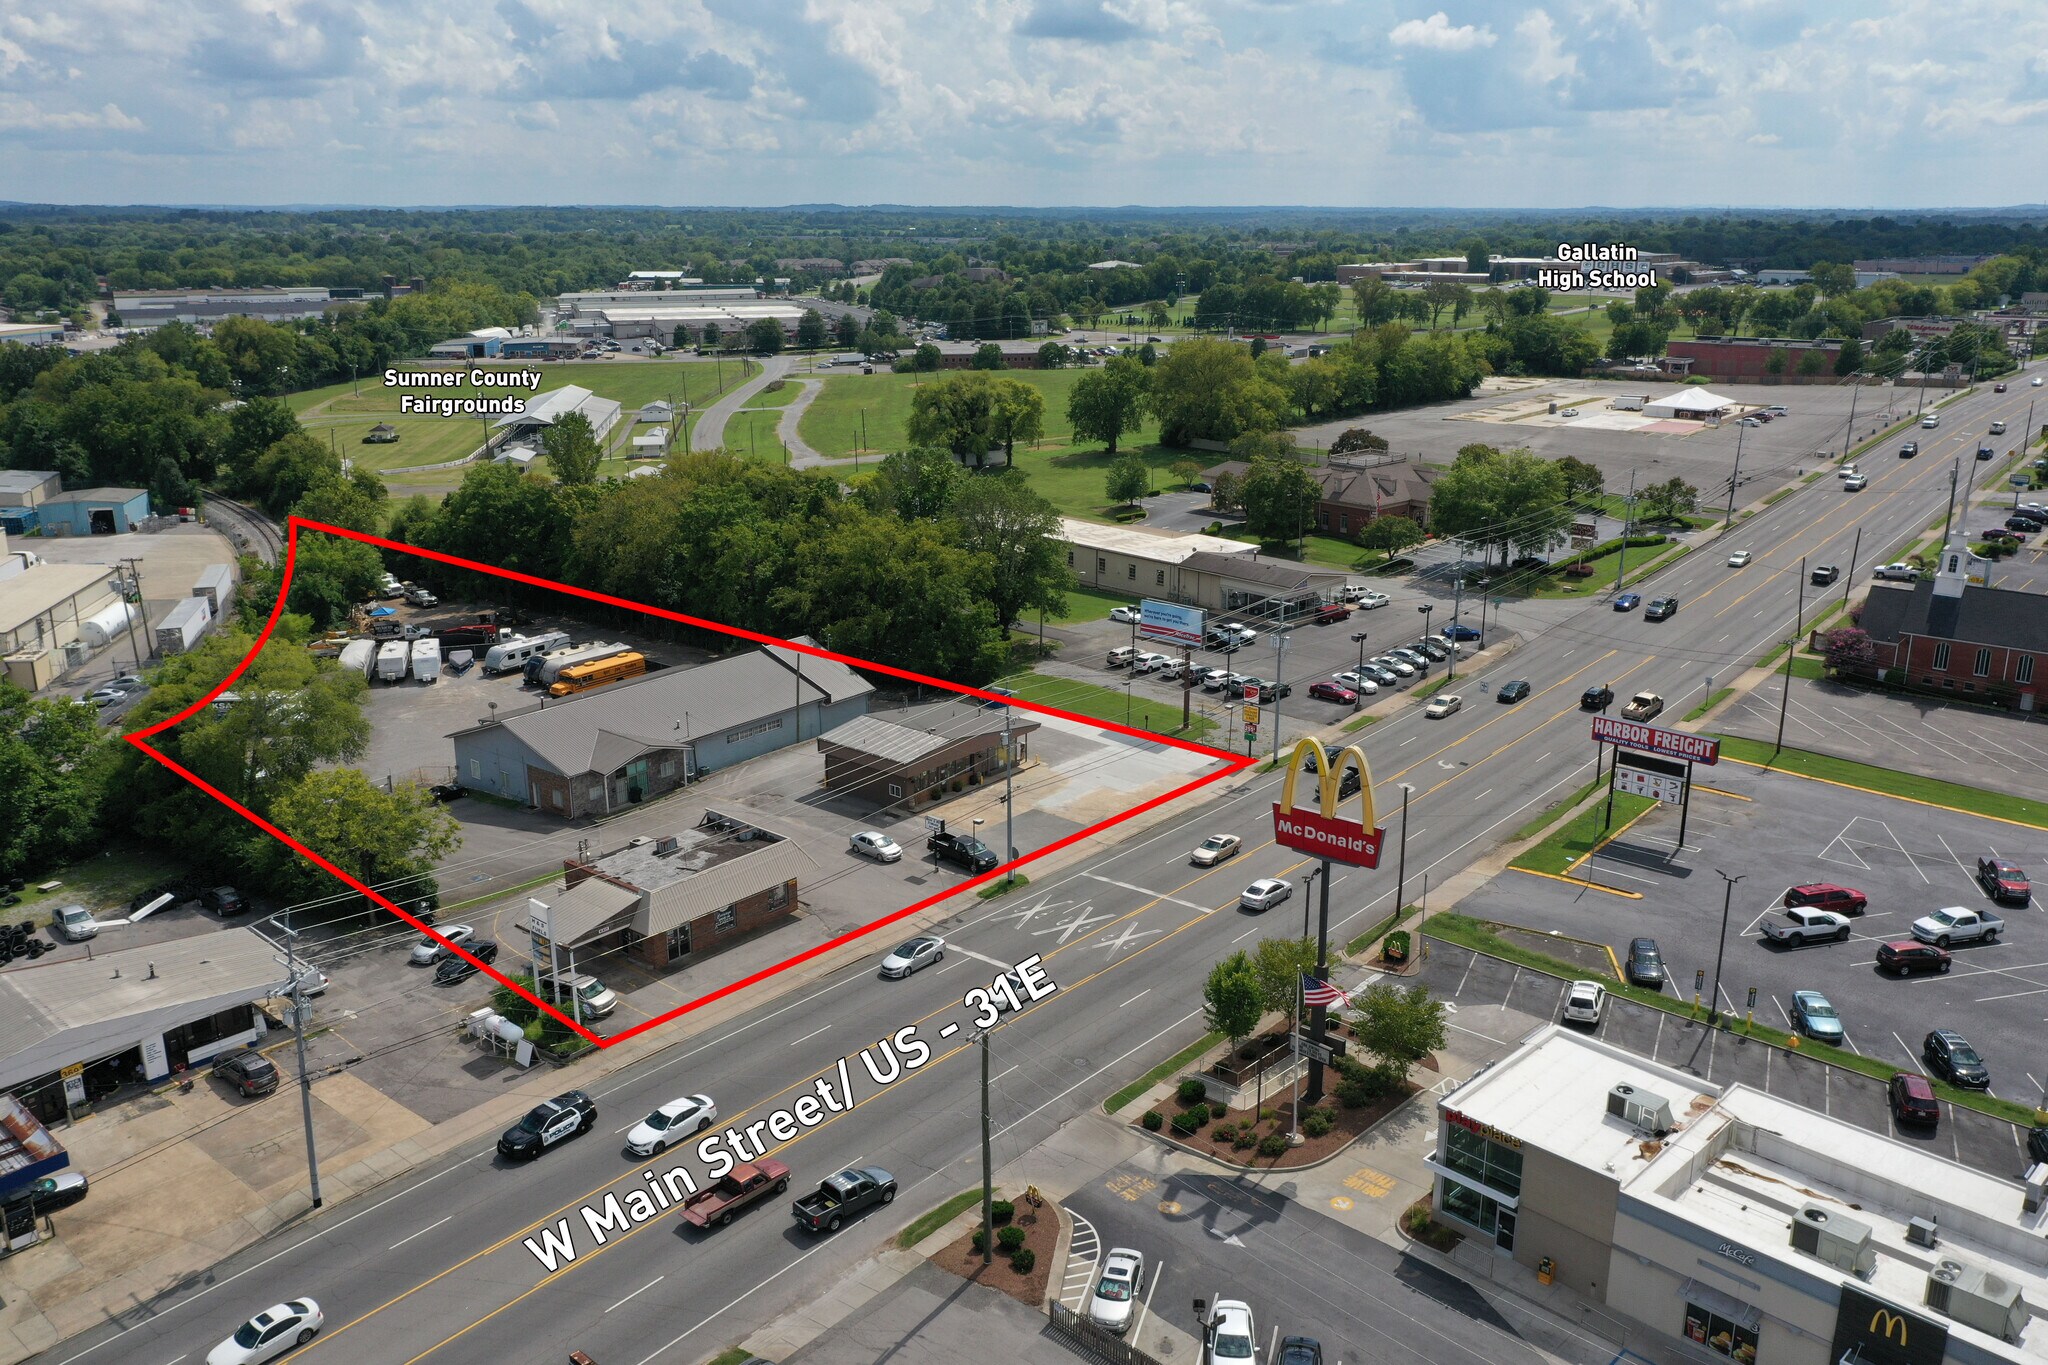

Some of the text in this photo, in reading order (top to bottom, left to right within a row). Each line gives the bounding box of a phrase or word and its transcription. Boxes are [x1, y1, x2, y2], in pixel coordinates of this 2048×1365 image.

[1594, 718, 1714, 757] HARBOR FREIGHT
[1604, 736, 1701, 761] QUALITY TOOLS LOWEST PRICES
[1277, 819, 1375, 855] McDonald's
[549, 1122, 575, 1138] POLICE
